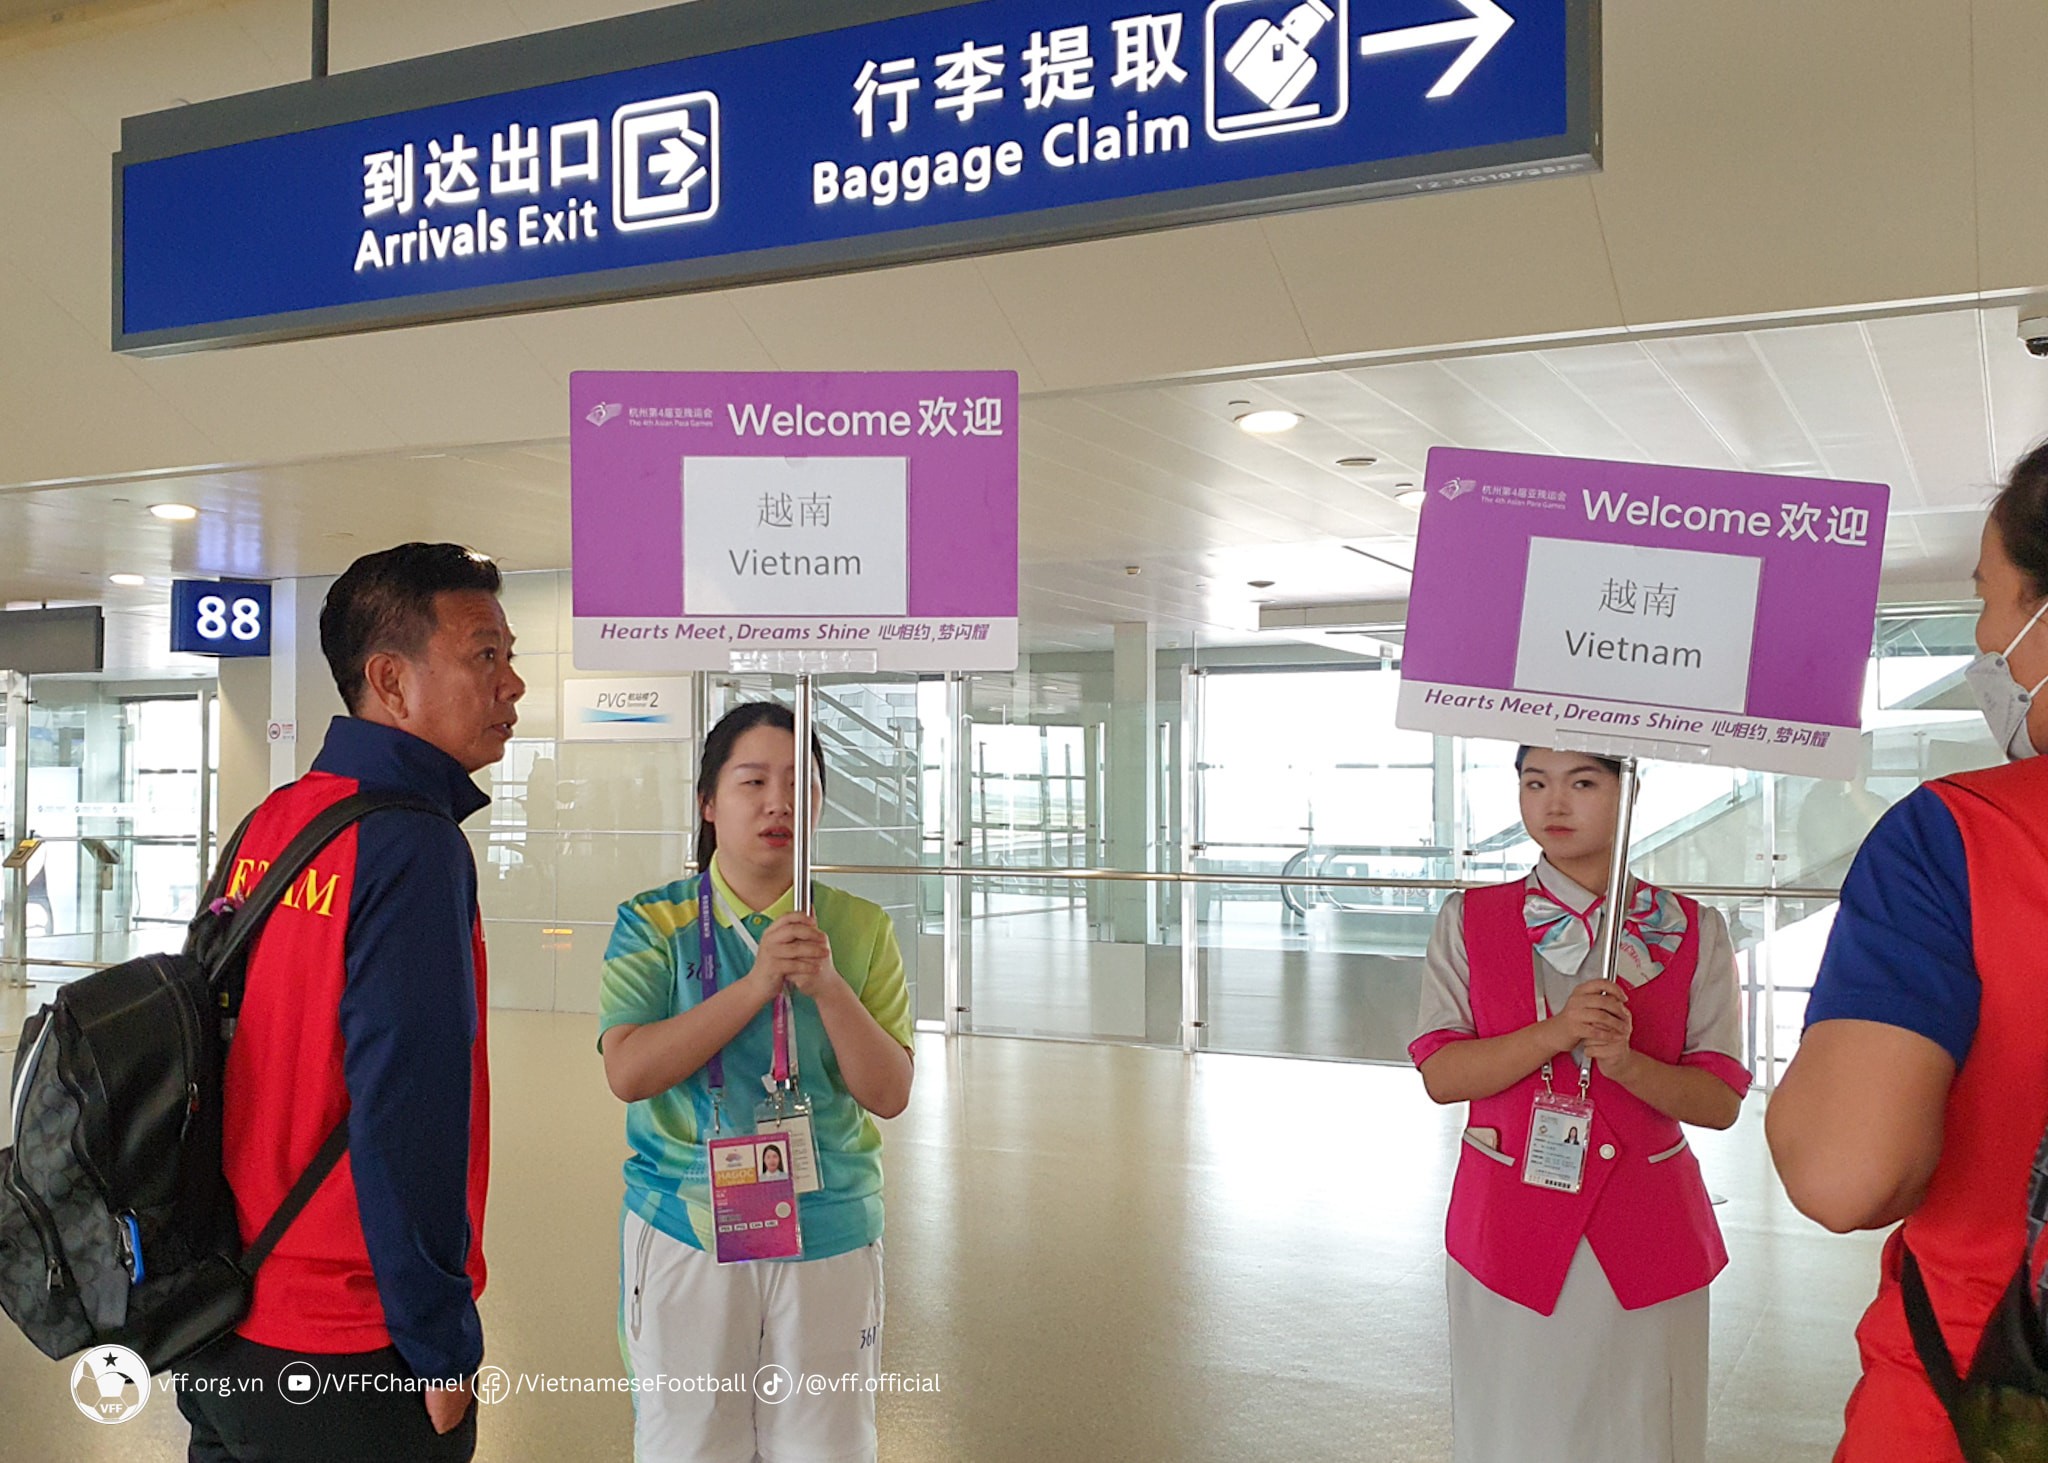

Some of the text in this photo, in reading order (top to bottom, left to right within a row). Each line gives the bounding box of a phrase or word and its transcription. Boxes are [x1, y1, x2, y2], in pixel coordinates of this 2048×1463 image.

[852, 12, 1188, 139] 行李提取
[362, 118, 600, 218] 到达出口
[811, 108, 1190, 206] Baggage Claim
[354, 198, 598, 272] Arrivals Exit
[727, 396, 1003, 438] Welcome 欢迎
[757, 491, 832, 529] 越南
[1582, 489, 1870, 548] Welcome 欢迎
[729, 550, 862, 577] Vietnam
[196, 595, 261, 641] 88
[1598, 577, 1681, 619] 越南
[601, 623, 669, 641] Hearts
[818, 623, 871, 641] Shine
[1565, 630, 1702, 669] Vietnam
[597, 692, 627, 708] PVG
[649, 691, 659, 708] 2
[1424, 688, 1494, 711] Hearts
[1646, 711, 1704, 734] Shine
